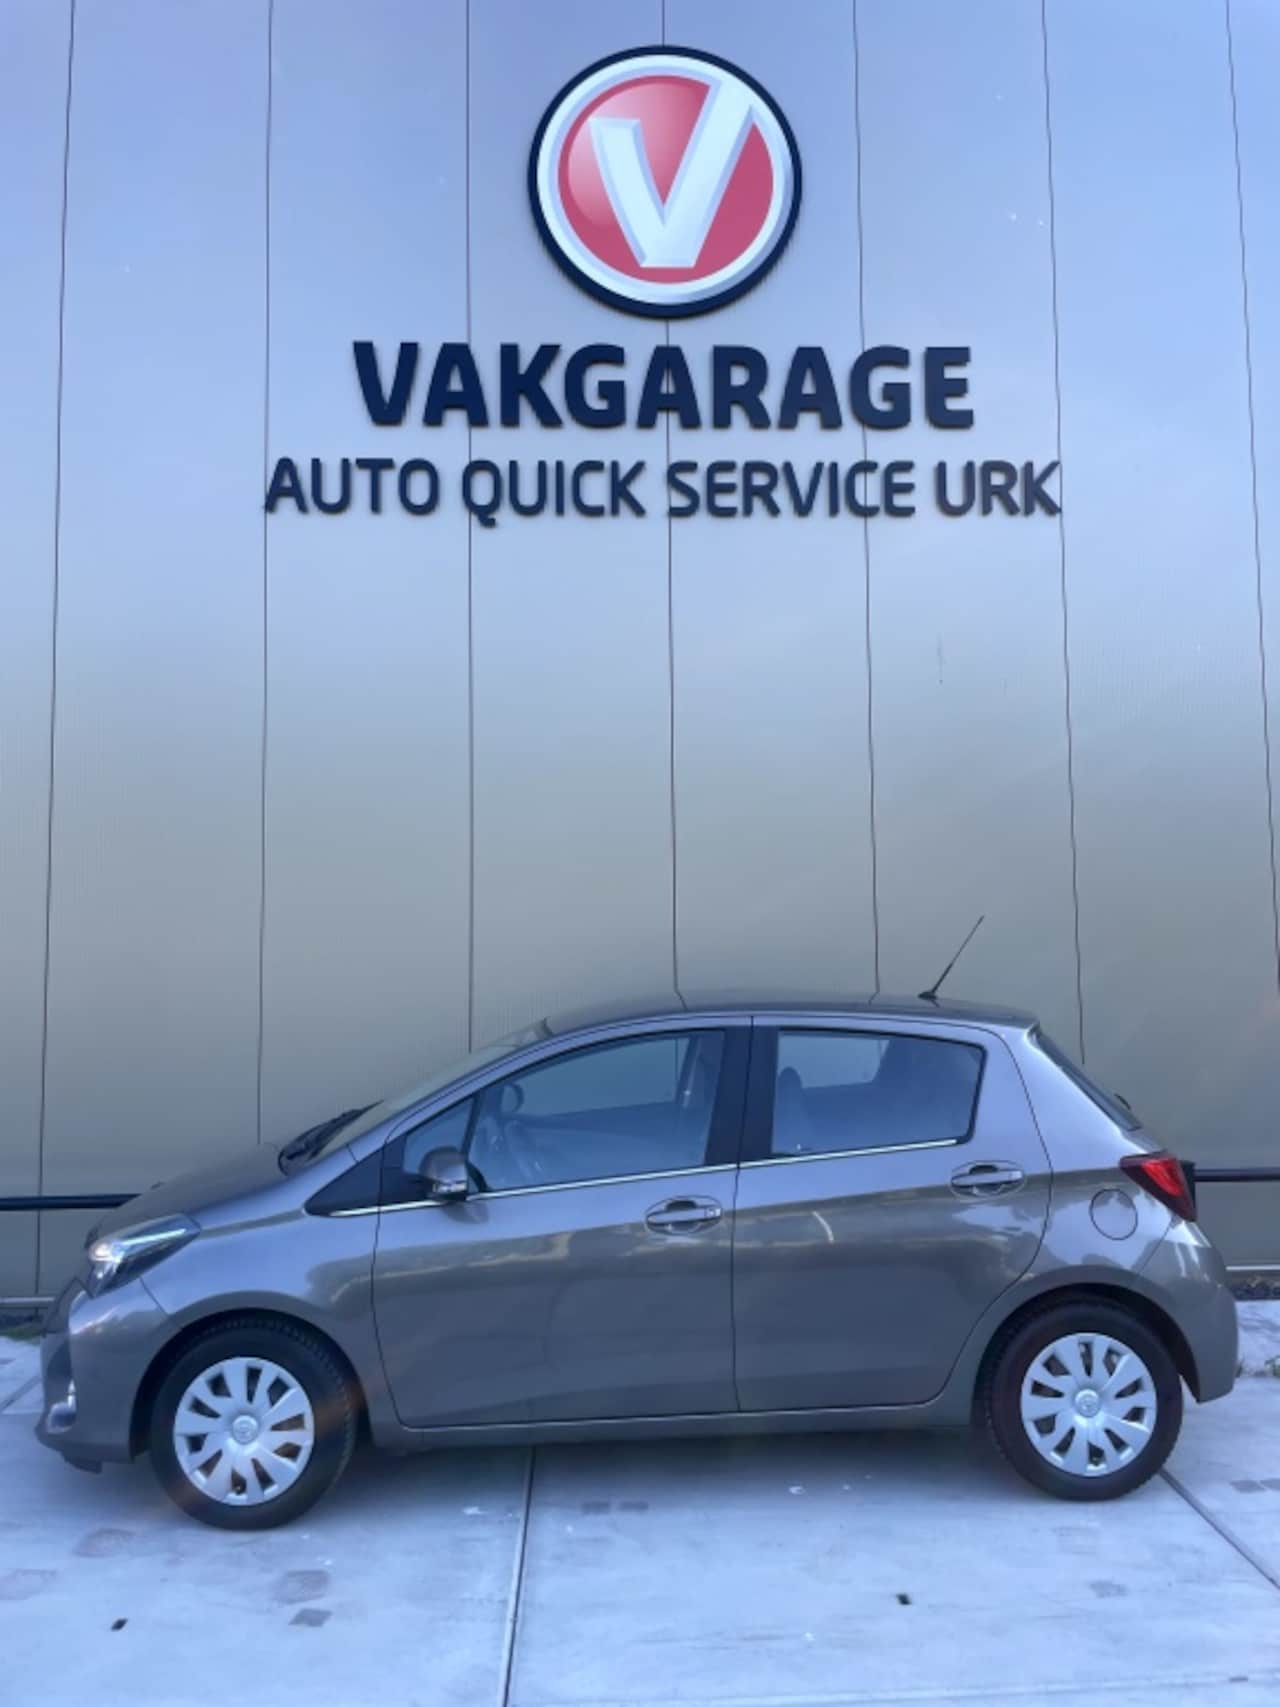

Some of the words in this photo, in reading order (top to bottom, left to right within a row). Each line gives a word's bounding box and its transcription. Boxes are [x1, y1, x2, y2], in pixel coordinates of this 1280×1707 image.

[588, 77, 755, 268] V
[353, 341, 974, 430] VAKGARAGE
[264, 457, 439, 515] AUTO
[461, 458, 645, 527] QUICK
[666, 460, 916, 517] SERVICE
[936, 461, 1062, 517] URK
